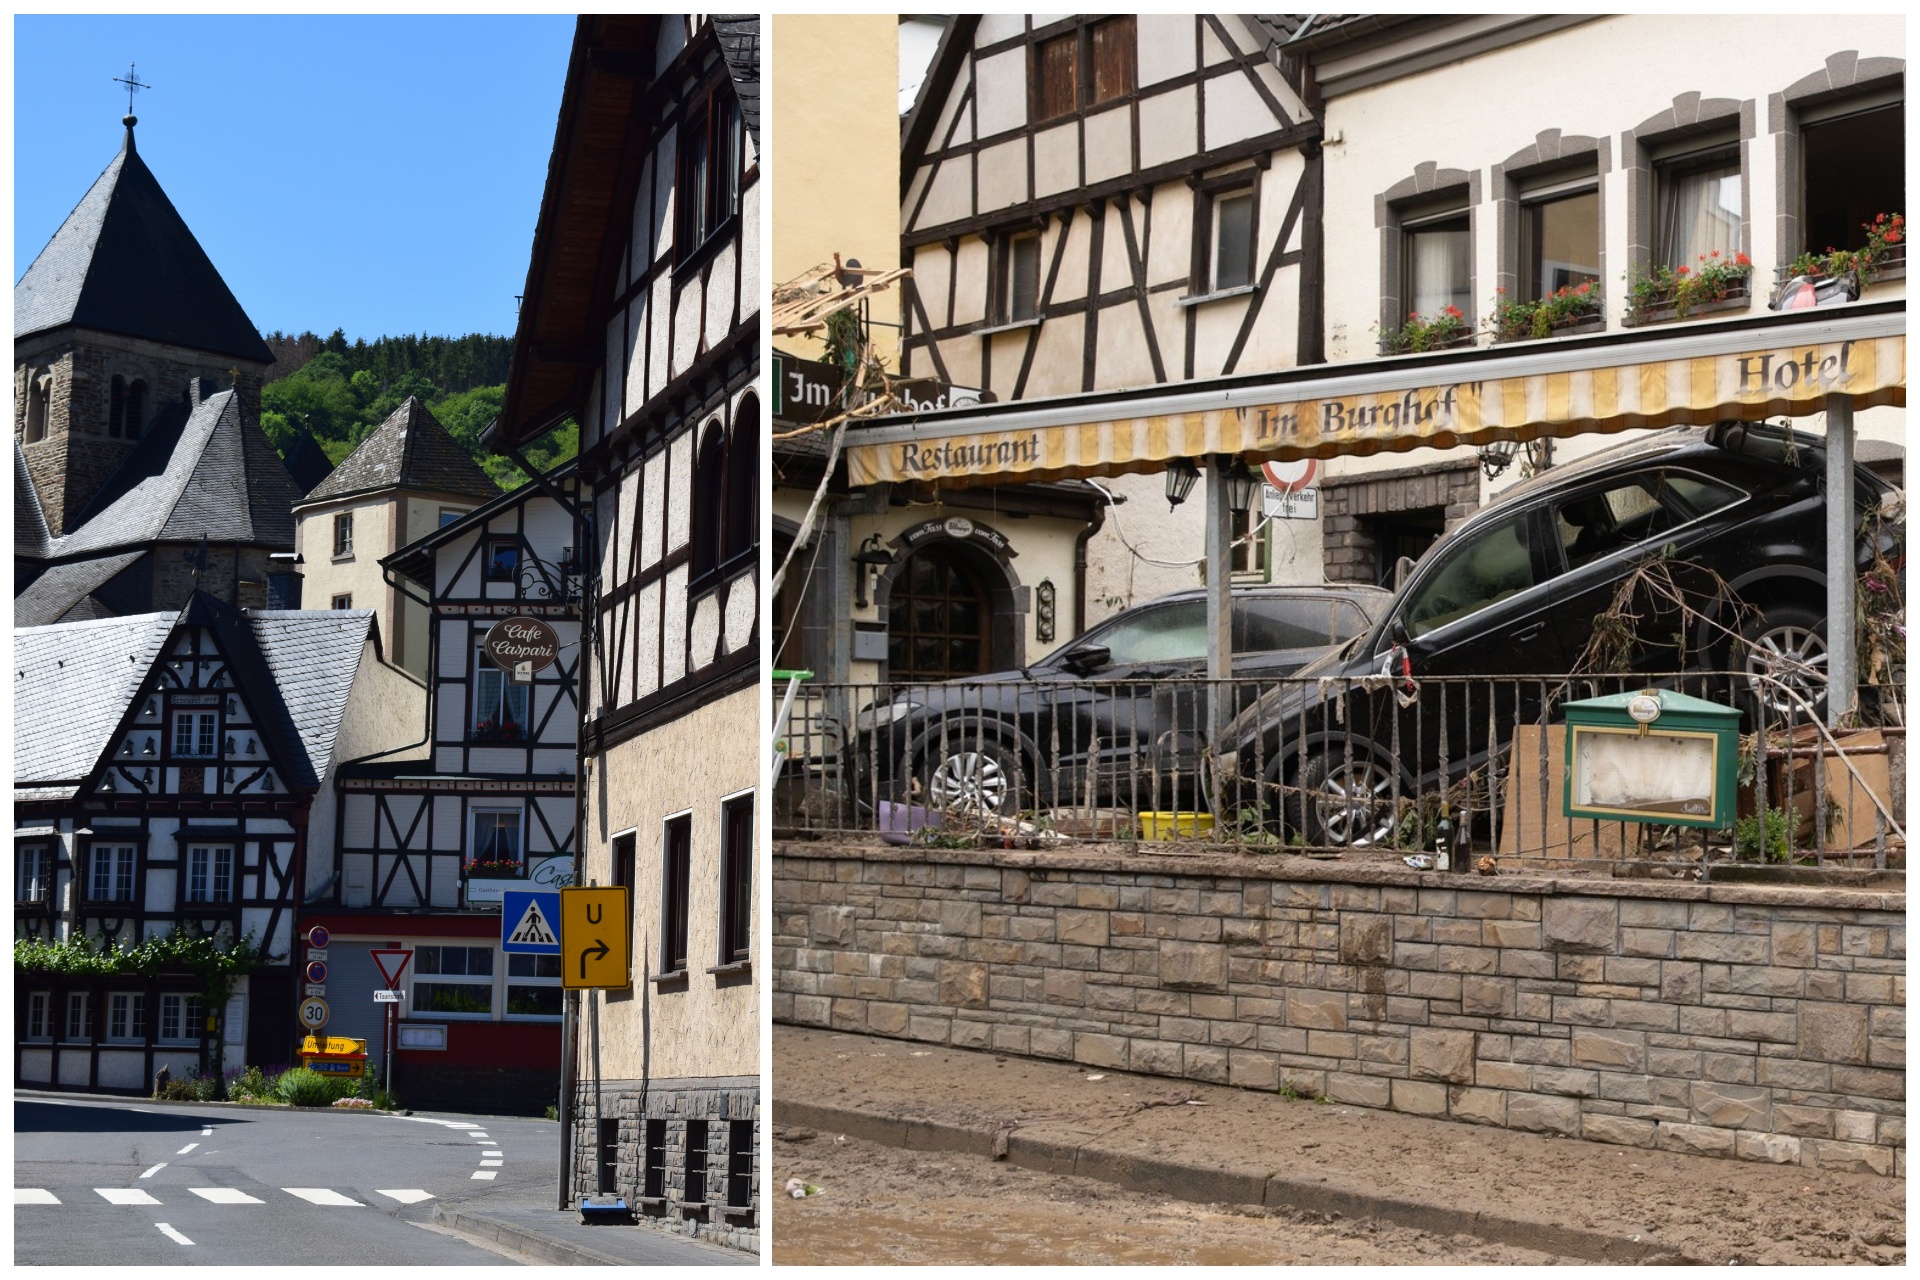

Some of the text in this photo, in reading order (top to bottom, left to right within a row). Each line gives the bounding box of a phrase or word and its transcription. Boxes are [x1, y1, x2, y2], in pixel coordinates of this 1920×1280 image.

[1735, 339, 1858, 395] Hotel
[788, 371, 830, 407] Im
[898, 433, 1041, 474] Restaurant
[1282, 501, 1297, 513] frei
[503, 624, 542, 643] Cafe
[491, 640, 553, 659] Caspari
[586, 903, 603, 925] U
[305, 1005, 324, 1022] 30
[307, 1039, 345, 1053] Umleitung
